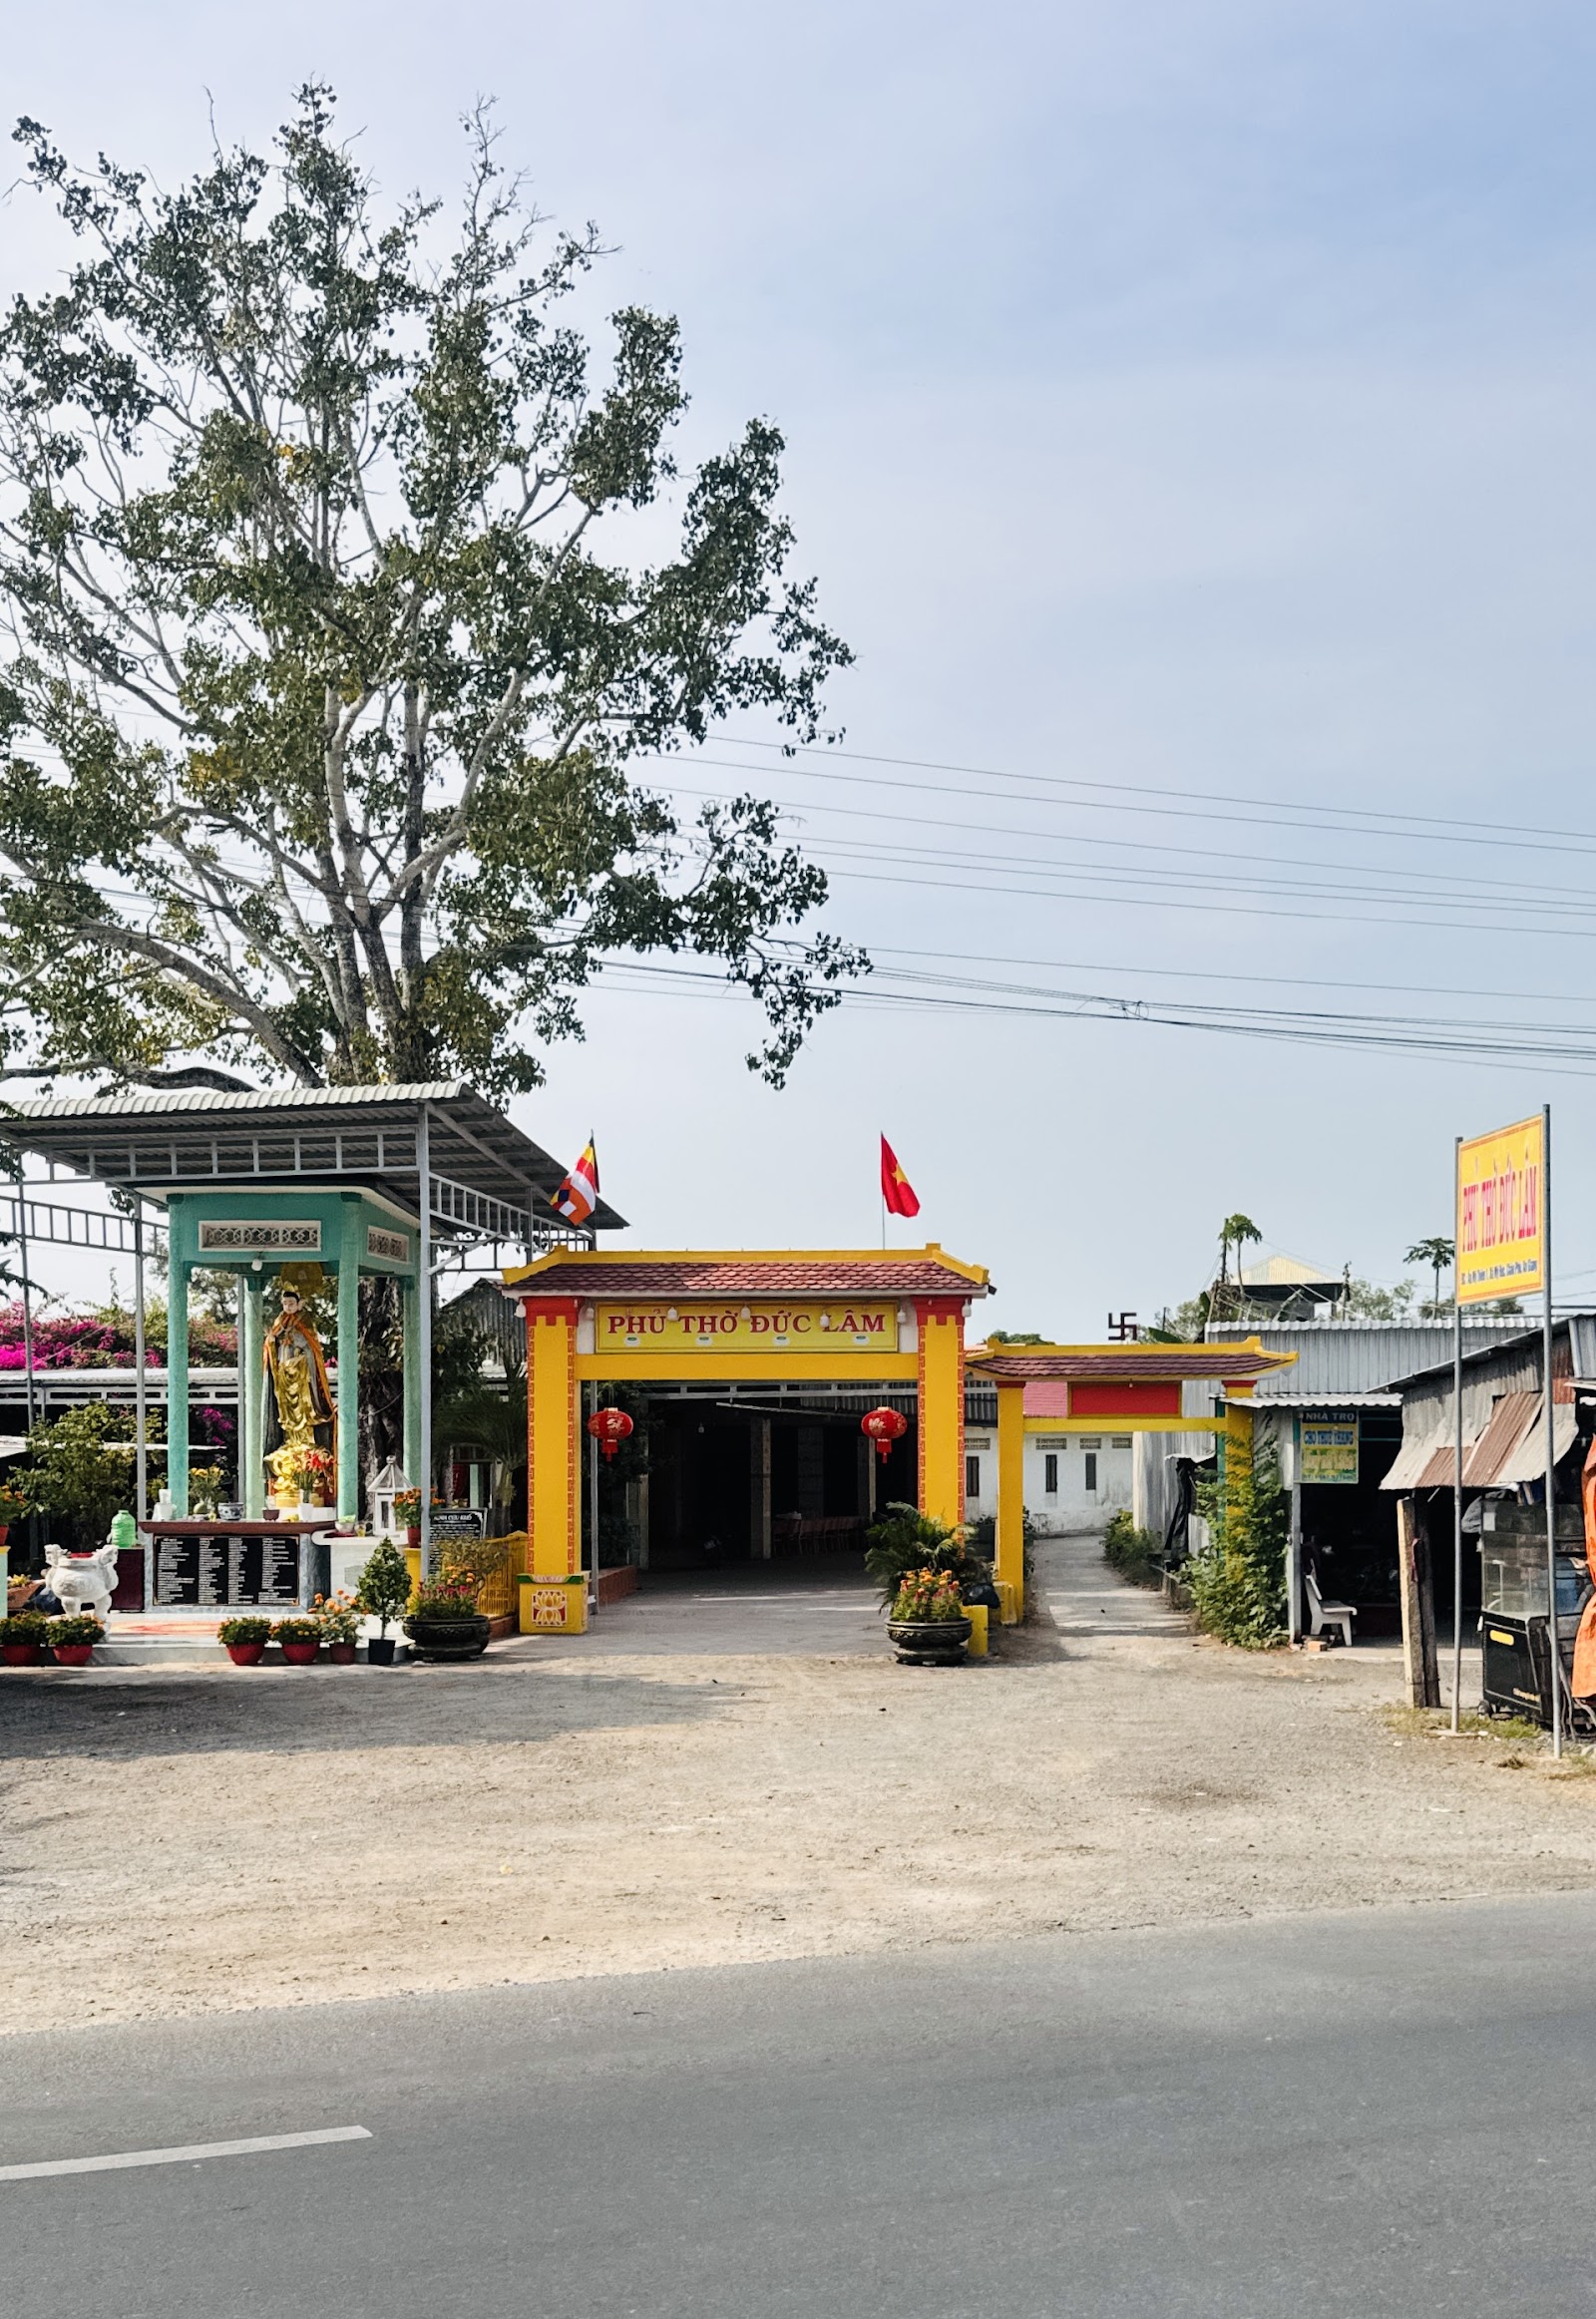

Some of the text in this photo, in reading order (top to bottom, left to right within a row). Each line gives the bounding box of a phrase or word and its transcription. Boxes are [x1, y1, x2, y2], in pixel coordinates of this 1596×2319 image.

[607, 1309, 885, 1334] PHỦ THỜ ĐỨC LÂM
[1306, 1410, 1329, 1421] NHÀ
